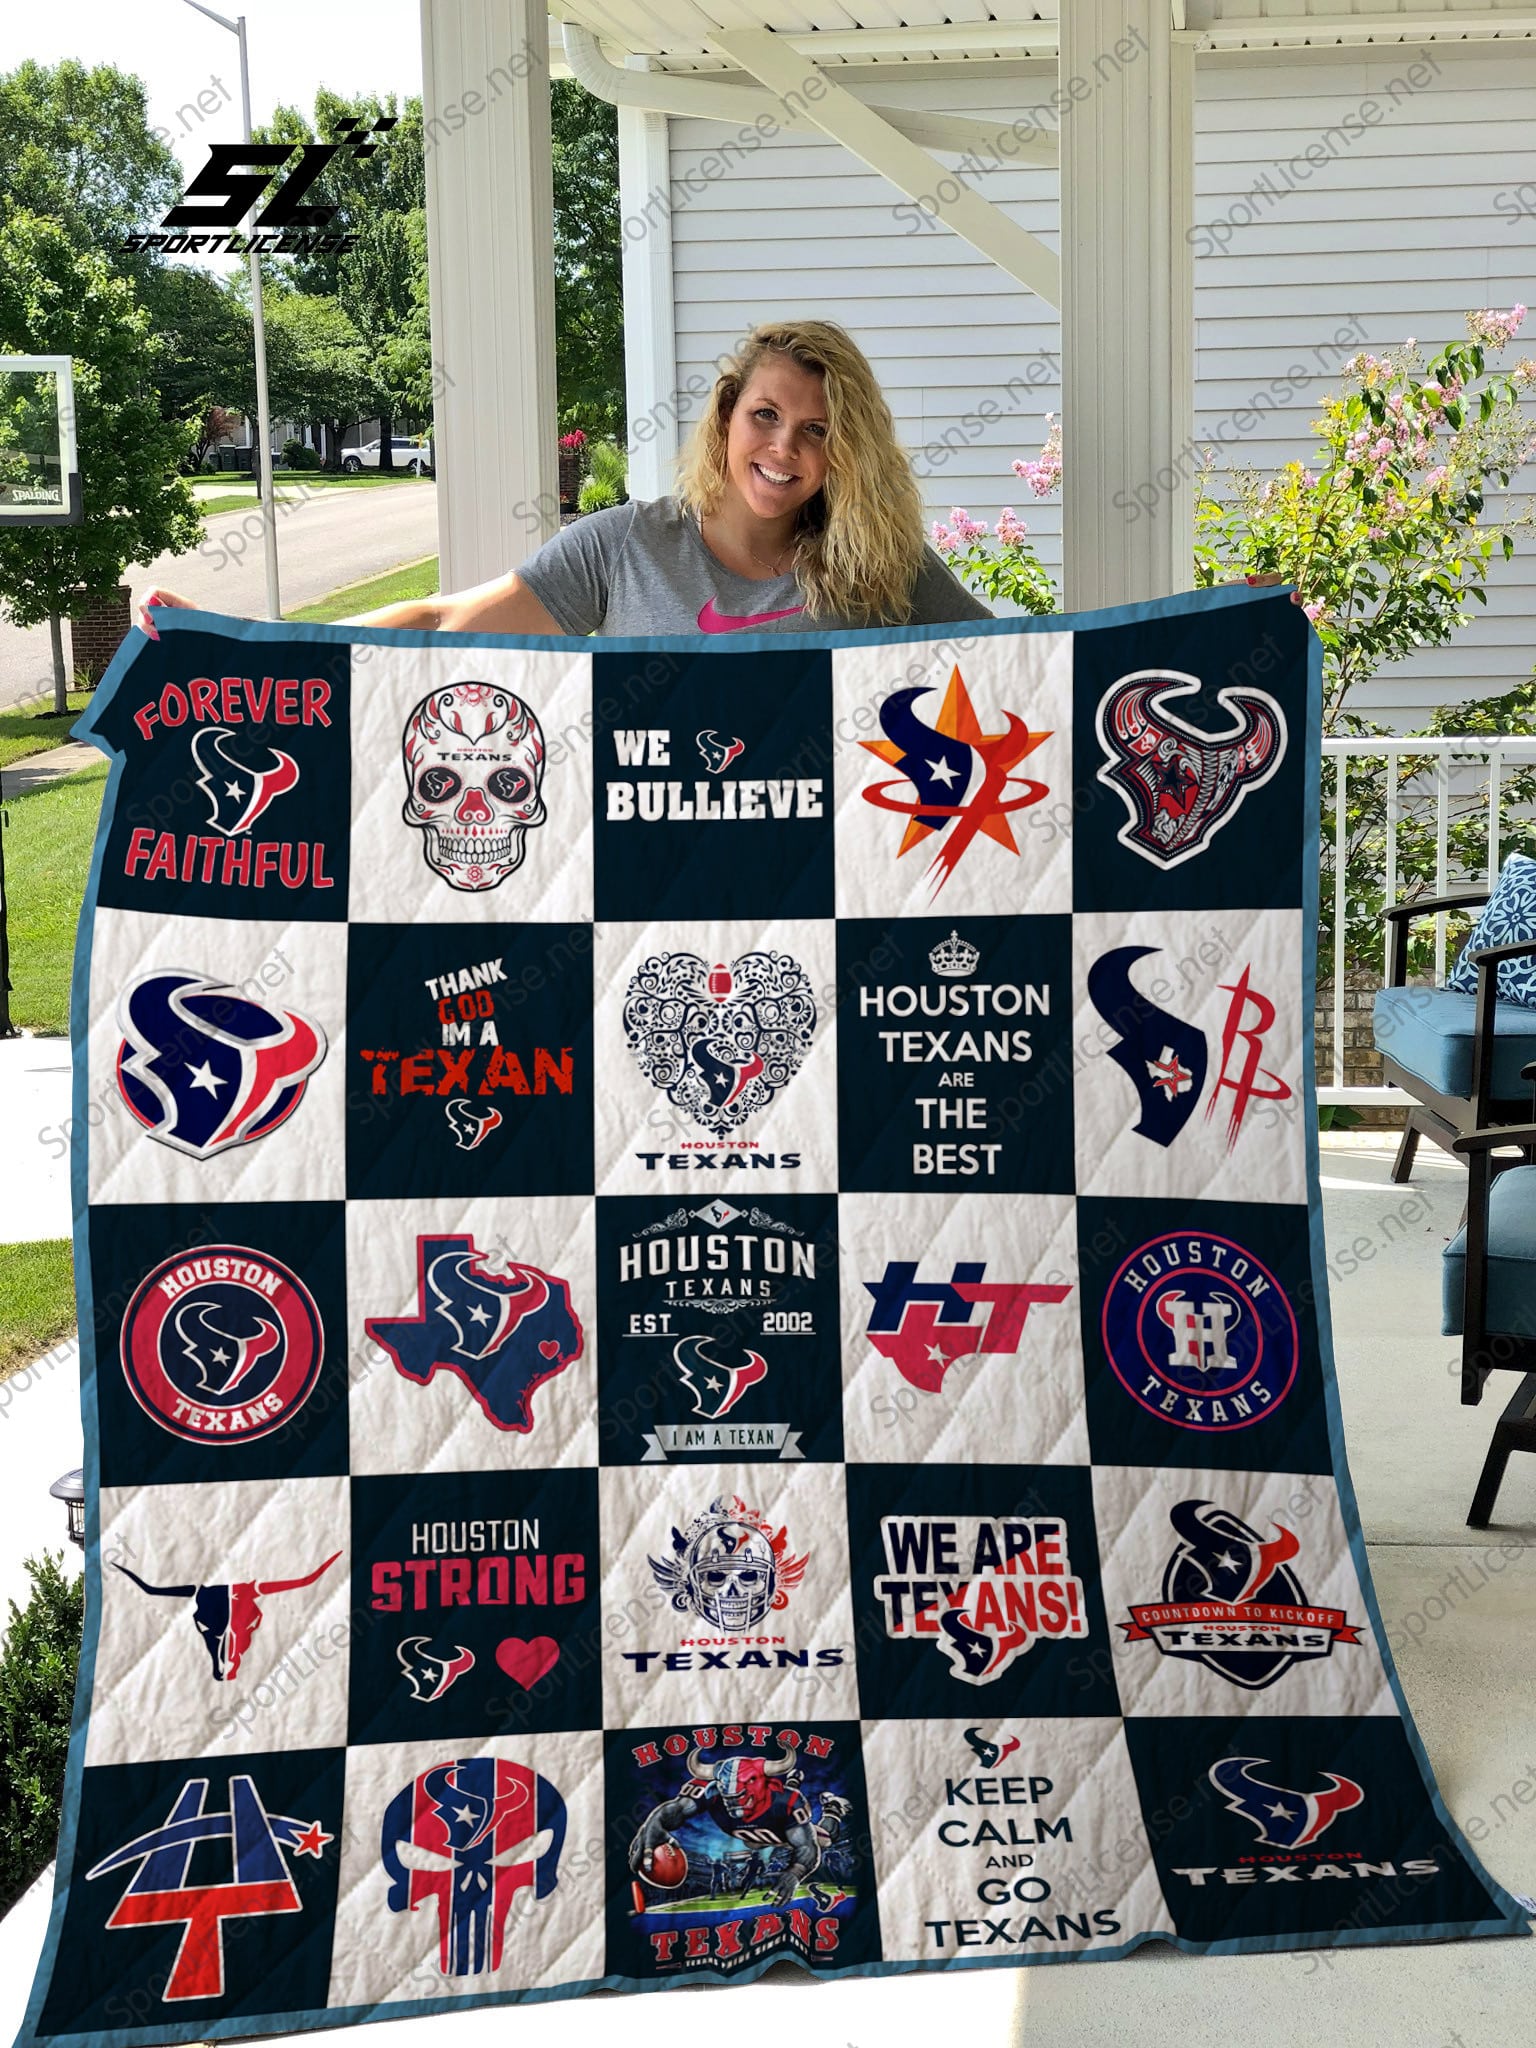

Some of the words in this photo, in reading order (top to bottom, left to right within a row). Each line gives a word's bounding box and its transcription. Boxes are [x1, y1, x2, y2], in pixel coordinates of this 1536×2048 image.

[12, 490, 61, 501] SPALDING
[134, 677, 332, 740] FOREVER
[437, 753, 512, 761] TEXANS
[613, 730, 670, 767] WE
[606, 778, 823, 821] BULLIEVE
[124, 829, 333, 889] FAITHFUL
[424, 958, 508, 1000] THANK
[438, 990, 494, 1024] GOD
[859, 984, 1050, 1017] HOUSTON
[442, 1022, 470, 1046] IM
[479, 1021, 500, 1046] A
[879, 1030, 1033, 1063] TEXANS
[359, 1045, 574, 1096] TEXAN
[938, 1071, 974, 1087] ARE
[915, 1099, 987, 1130] THE
[635, 1152, 801, 1170] TEXANS
[680, 1141, 759, 1150] HOUSTON
[912, 1144, 1002, 1175] BEST
[620, 1234, 816, 1282] HOUSTON
[1123, 1241, 1270, 1298] HOUSTON
[157, 1257, 282, 1301] HOUSTON
[666, 1278, 771, 1298] TEXANS
[630, 1314, 671, 1334] EST
[763, 1312, 812, 1332] 2002
[172, 1392, 284, 1432] TEXANS
[1141, 1375, 1271, 1422] TEXANS
[674, 1430, 678, 1446] I
[686, 1430, 706, 1445] AM
[714, 1430, 722, 1445] A
[730, 1429, 774, 1444] TEXAN
[411, 1520, 540, 1554] HOUSTON
[887, 1522, 959, 1575] WE
[971, 1522, 1064, 1575] ARE
[371, 1553, 586, 1612] STRONG
[881, 1581, 1083, 1633] TEXANS!
[1141, 1606, 1236, 1622] COUNTDOWN
[1244, 1606, 1262, 1617] TO
[1270, 1608, 1335, 1624] KICKOFF
[680, 1636, 786, 1646] HOUSTON
[1162, 1631, 1325, 1647] TEXANS
[621, 1648, 844, 1673] TEXANS
[632, 1726, 834, 1767] HOUSTON
[945, 1776, 1053, 1806] KEEP
[938, 1817, 1073, 1847] CALM
[985, 1854, 1034, 1868] AND
[1170, 1859, 1440, 1886] TEXANS
[1237, 1852, 1363, 1863] HOUSTON
[977, 1877, 1051, 1905] GO
[651, 1909, 839, 1961] TEXANS
[924, 1909, 1122, 1947] TEXANS
